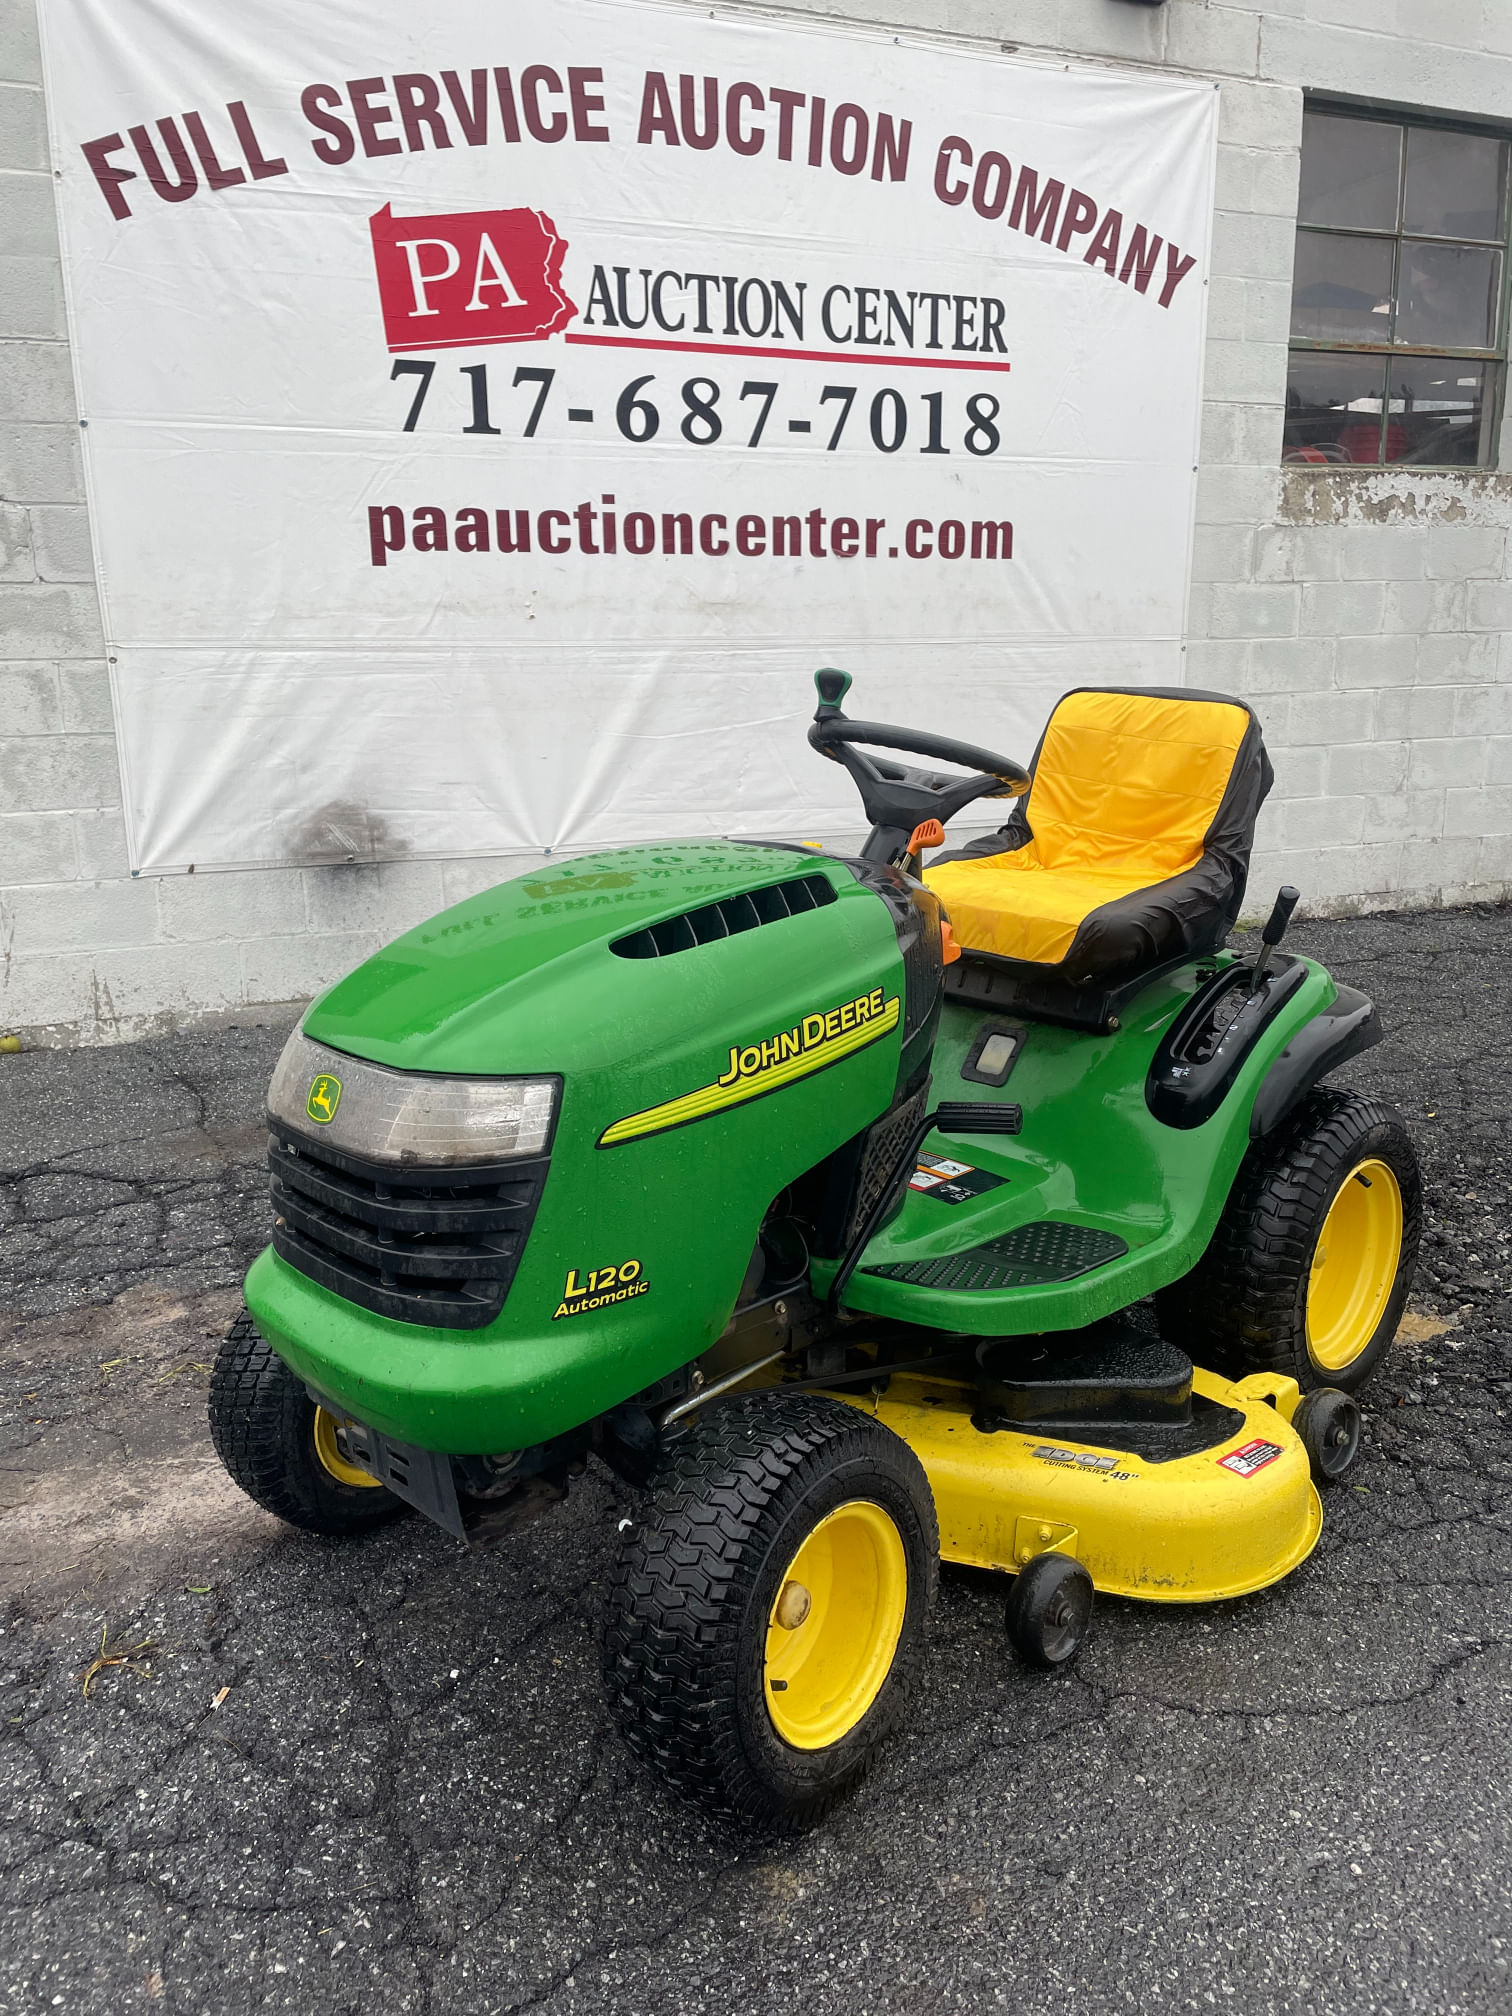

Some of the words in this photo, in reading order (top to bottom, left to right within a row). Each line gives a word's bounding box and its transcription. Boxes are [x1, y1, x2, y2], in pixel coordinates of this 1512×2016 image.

[81, 101, 288, 220] FULL
[301, 65, 609, 165] SERVICE
[638, 71, 912, 182] AUCTION
[934, 136, 1196, 309] COMPANY
[395, 232, 528, 317] PA
[584, 265, 807, 341] AUCTION
[822, 285, 1008, 354] CENTER
[368, 494, 1013, 566] paauctioncenter.com
[719, 1028, 799, 1085] JOHN
[803, 988, 883, 1048] DEERE
[554, 1281, 648, 1318] Automatic
[564, 1260, 640, 1299] L120
[1043, 1460, 1076, 1470] CUTTING
[1077, 1466, 1109, 1476] SYSTEM
